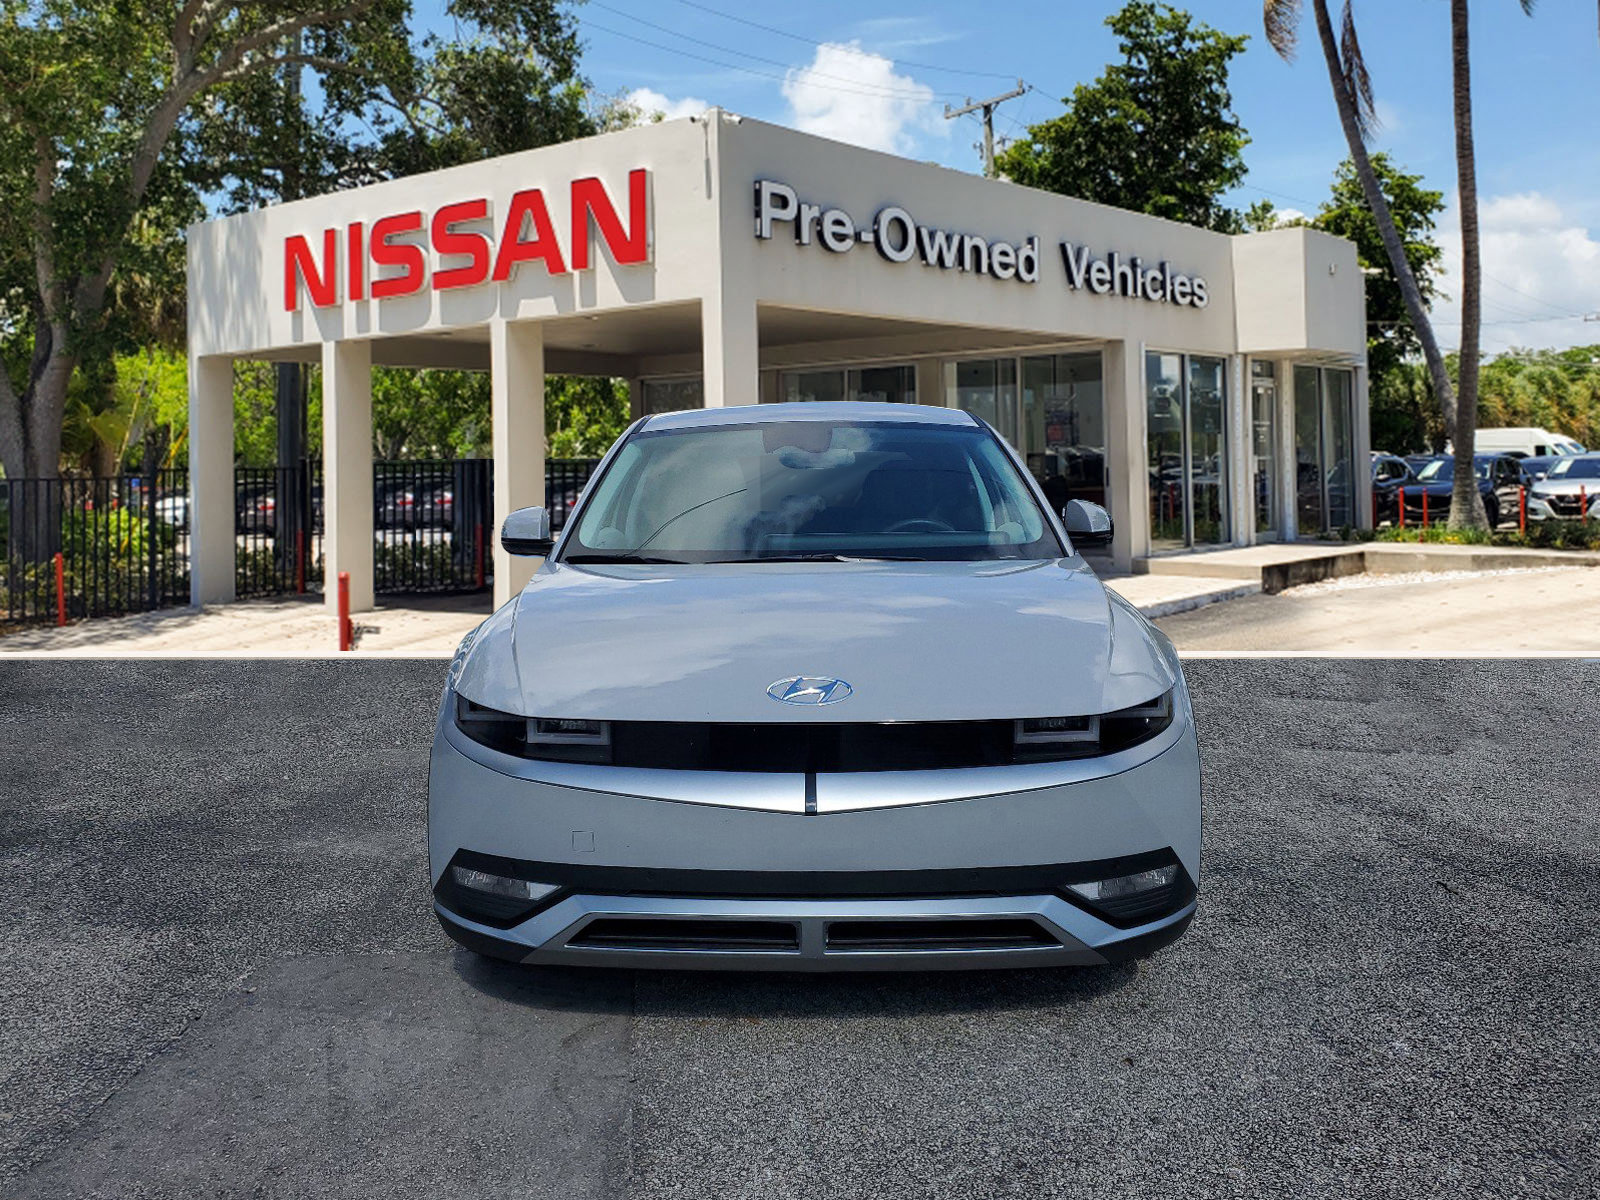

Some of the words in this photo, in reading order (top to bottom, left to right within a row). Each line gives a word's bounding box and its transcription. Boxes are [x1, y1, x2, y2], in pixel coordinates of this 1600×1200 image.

[284, 168, 649, 311] NISSAN
[755, 179, 1040, 283] Pre-Owned
[1060, 241, 1208, 308] Vehicles
